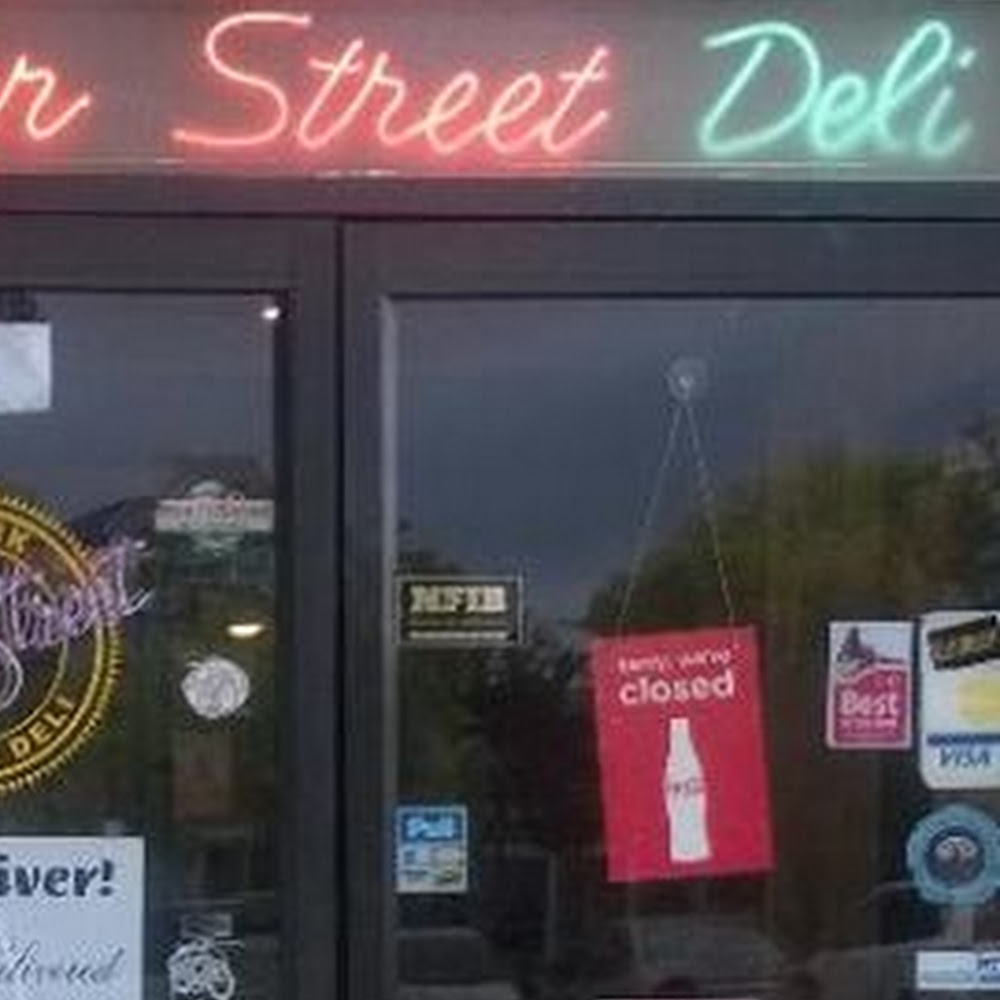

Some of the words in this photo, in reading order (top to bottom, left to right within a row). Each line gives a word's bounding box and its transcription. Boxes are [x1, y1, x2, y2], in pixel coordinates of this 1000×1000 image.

[172, 11, 612, 153] Street
[700, 20, 980, 156] Deli
[618, 668, 736, 705] closed
[9, 694, 77, 754] DELI
[938, 746, 992, 768] VISA
